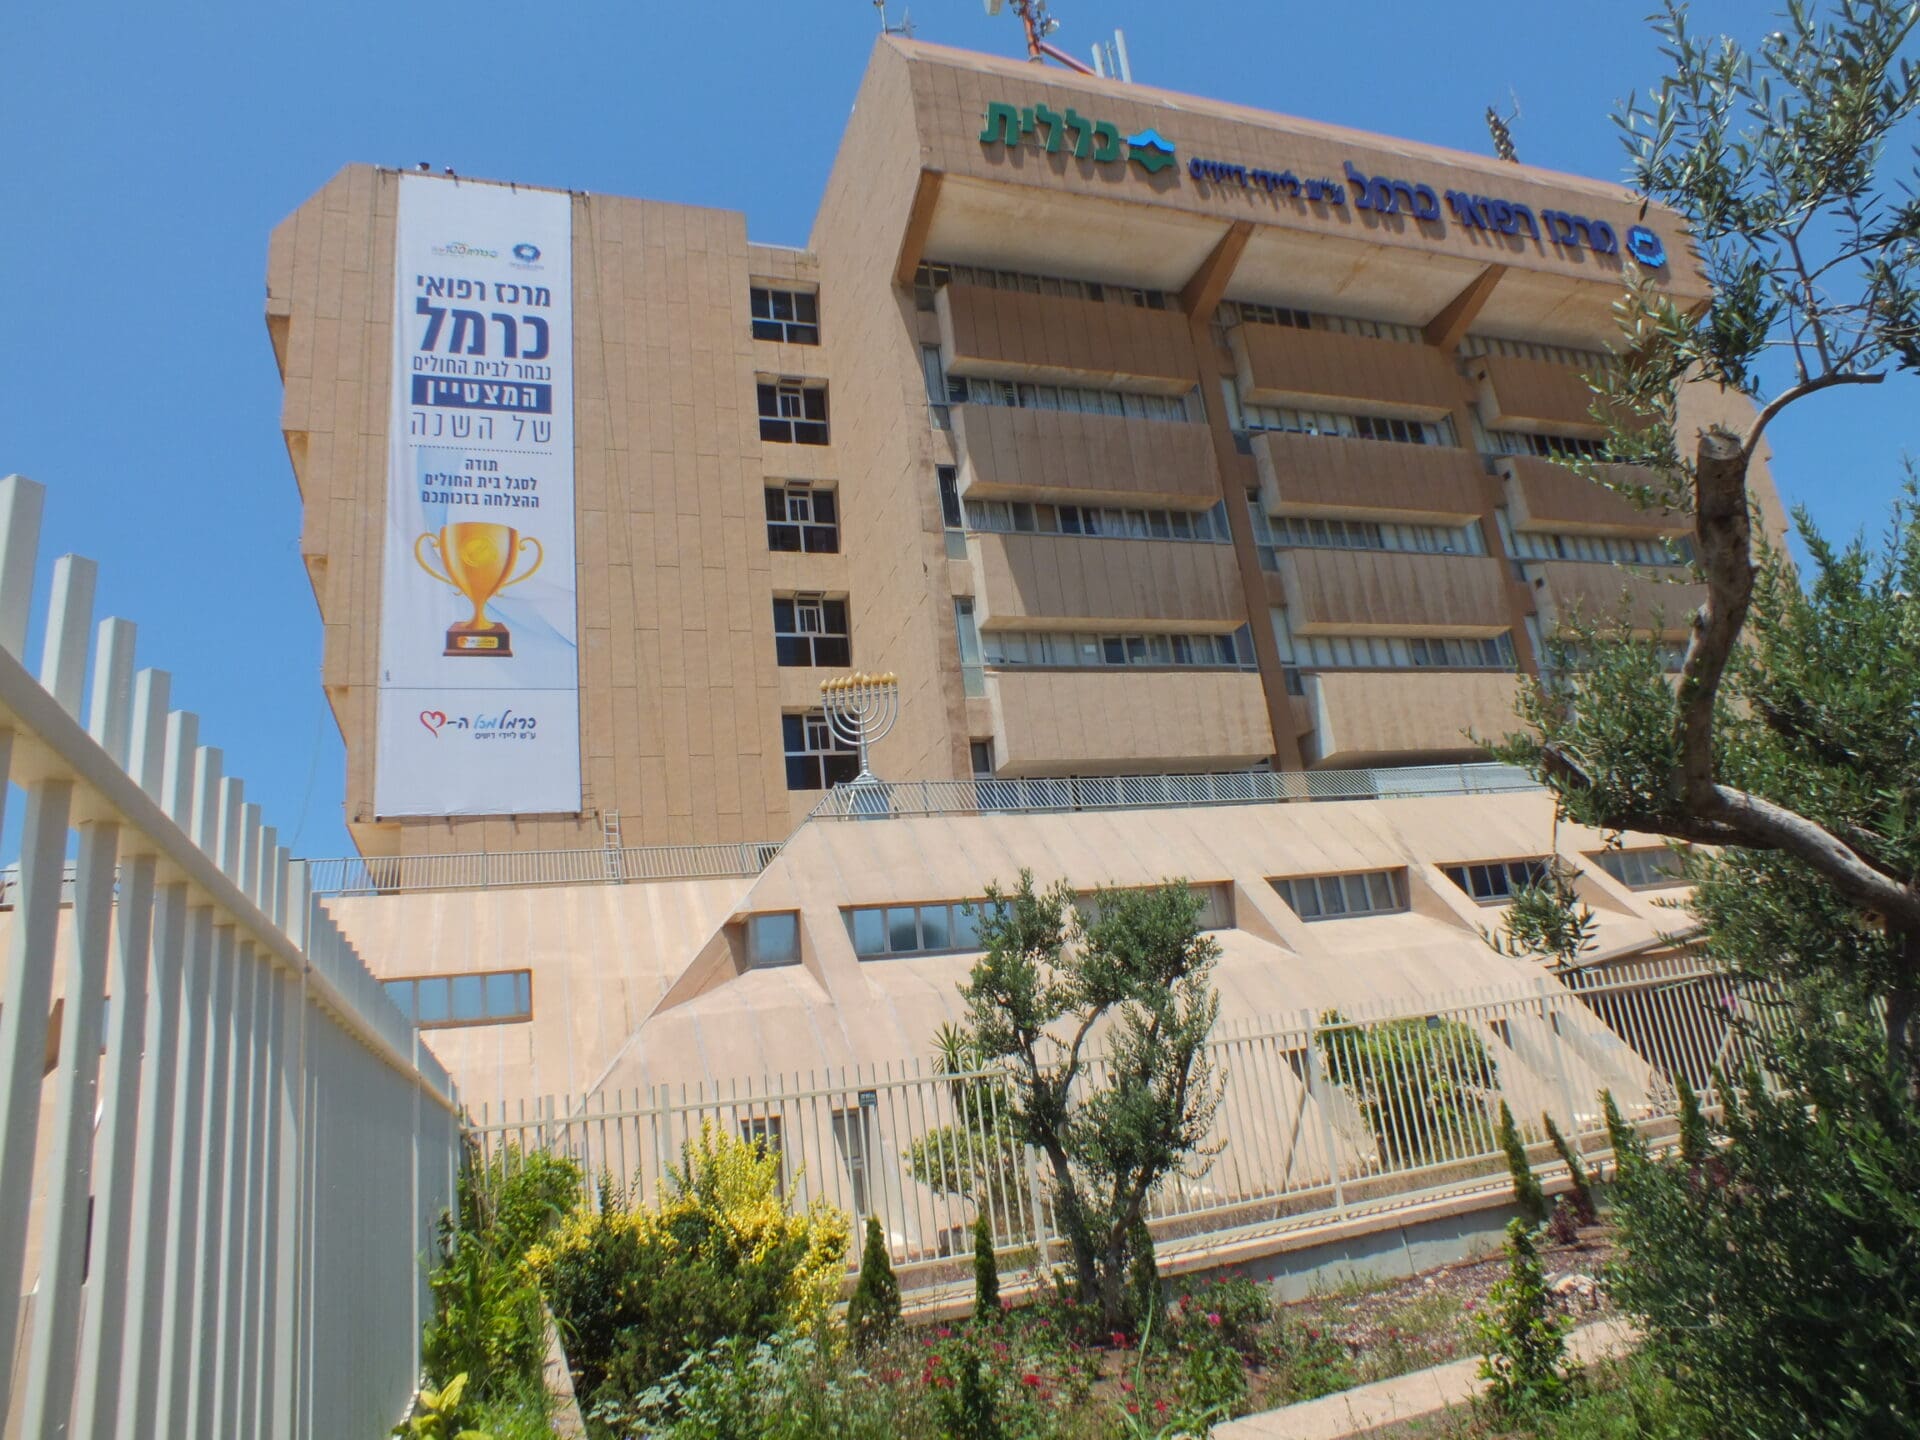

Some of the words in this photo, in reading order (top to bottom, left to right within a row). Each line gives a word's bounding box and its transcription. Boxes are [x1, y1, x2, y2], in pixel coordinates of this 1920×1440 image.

[979, 101, 1121, 163] כללית
[1251, 169, 1301, 197] ליידי
[1305, 177, 1345, 205] ע"ש
[1344, 160, 1441, 221] כרמל
[1444, 189, 1541, 241] רפואי
[1541, 208, 1619, 255] מרכז
[417, 274, 486, 301] רפואי
[494, 282, 550, 307] מרכז
[416, 296, 550, 360] כרמל
[413, 355, 468, 375] החולים
[474, 360, 509, 378] לבית
[515, 364, 551, 381] נבחר
[427, 380, 537, 408] המצטיין
[411, 411, 493, 440] השנה
[512, 415, 550, 443] של
[465, 459, 498, 472] תודה
[425, 472, 472, 488] החולים
[477, 476, 501, 489] בית
[506, 476, 537, 491] לסגל
[422, 490, 480, 506] בזכותכם
[484, 493, 540, 508] ההצלחה
[473, 714, 498, 729] מכל
[499, 709, 536, 729] כרמל
